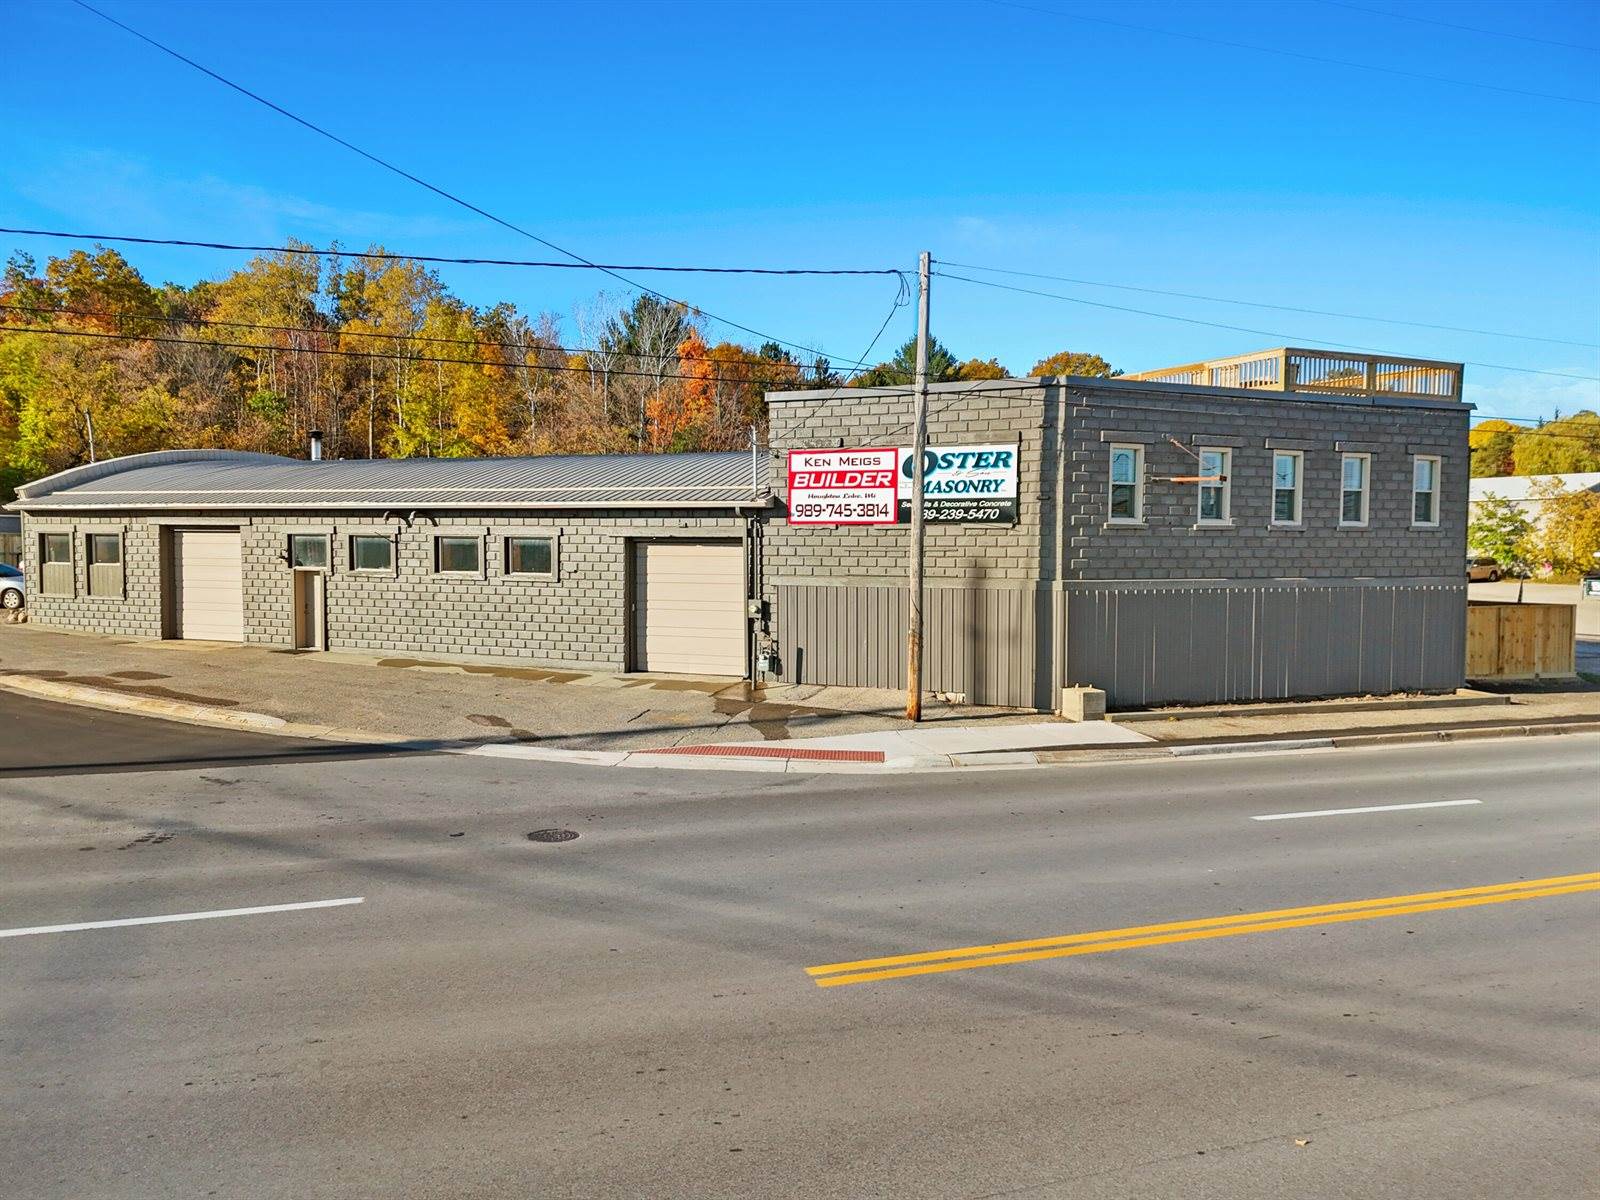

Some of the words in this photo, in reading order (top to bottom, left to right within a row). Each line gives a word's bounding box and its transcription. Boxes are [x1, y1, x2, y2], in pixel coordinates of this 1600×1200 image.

[804, 457, 831, 467] KEN
[839, 456, 881, 466] MEIGS
[793, 472, 893, 487] BUILDER
[795, 503, 889, 517] 989-745-3814
[940, 500, 977, 508] Decorative
